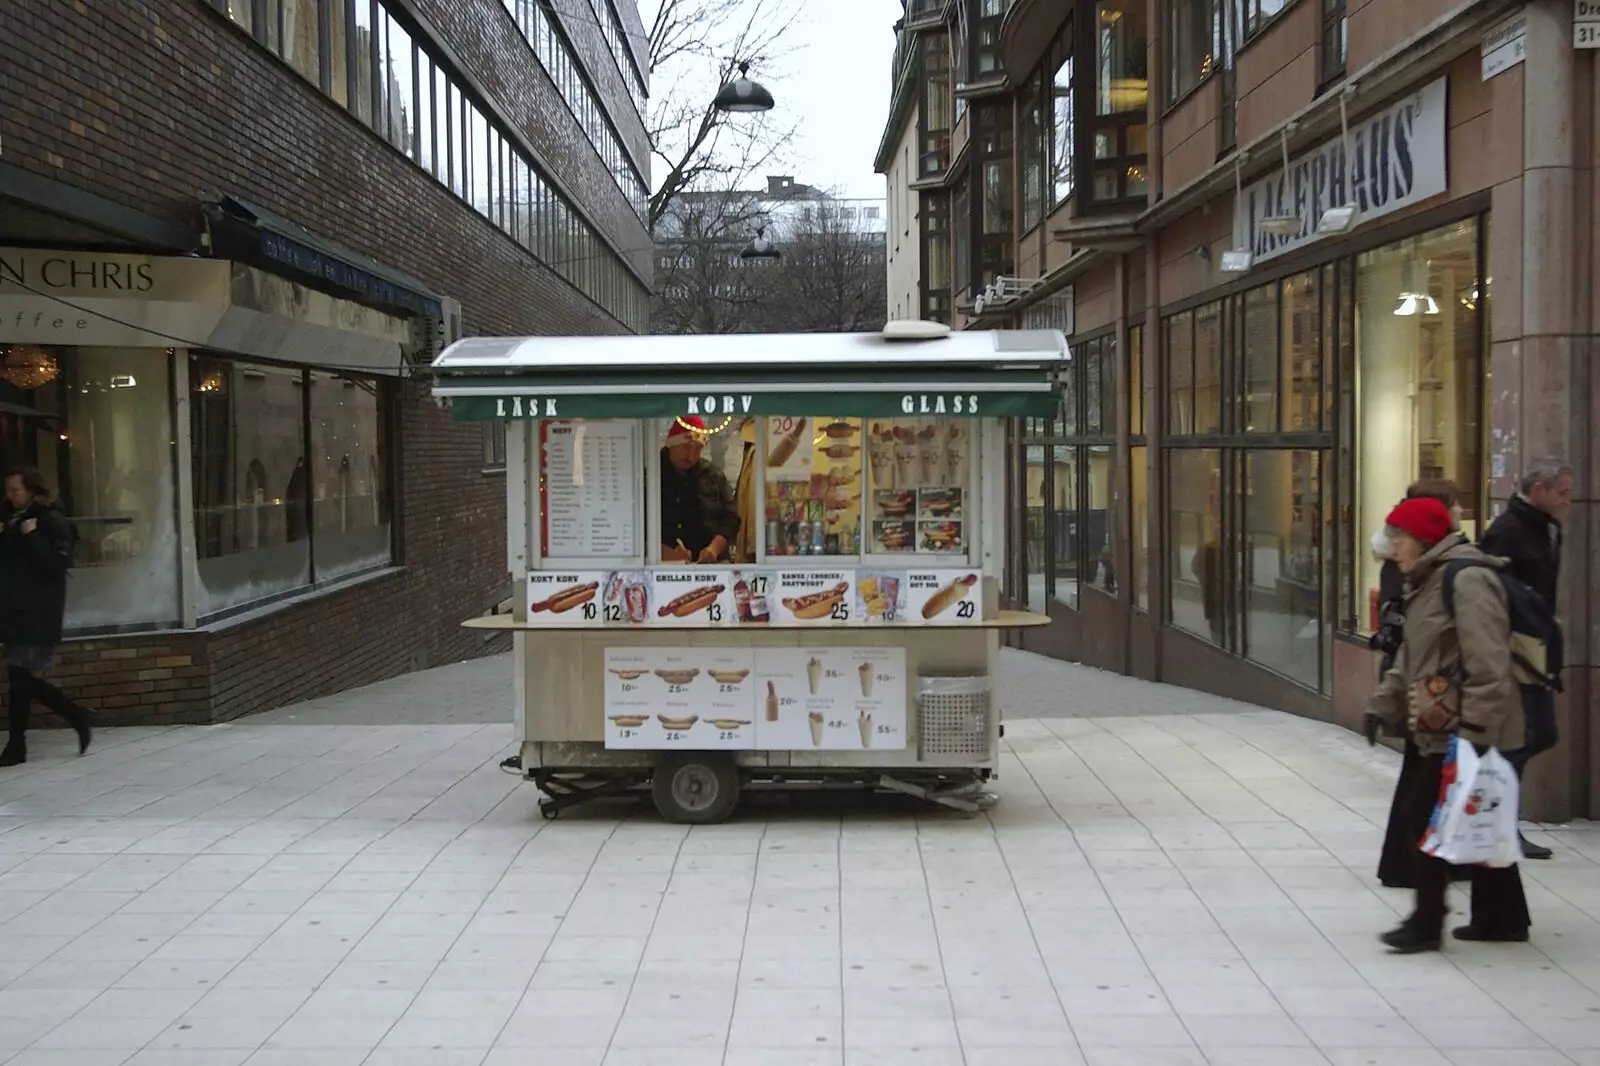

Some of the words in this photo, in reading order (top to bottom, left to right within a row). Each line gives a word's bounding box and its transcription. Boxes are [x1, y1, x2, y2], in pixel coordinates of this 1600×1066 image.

[42, 258, 153, 292] CHRIS
[0, 311, 87, 329] ffee
[496, 396, 557, 417] LÄSK
[687, 395, 753, 414] KORV
[901, 395, 978, 414] GLASS
[751, 577, 768, 593] 17
[582, 603, 596, 620] 10
[604, 605, 620, 621] 12
[707, 604, 721, 621] 13
[831, 604, 848, 620] 25
[957, 601, 974, 618] 20
